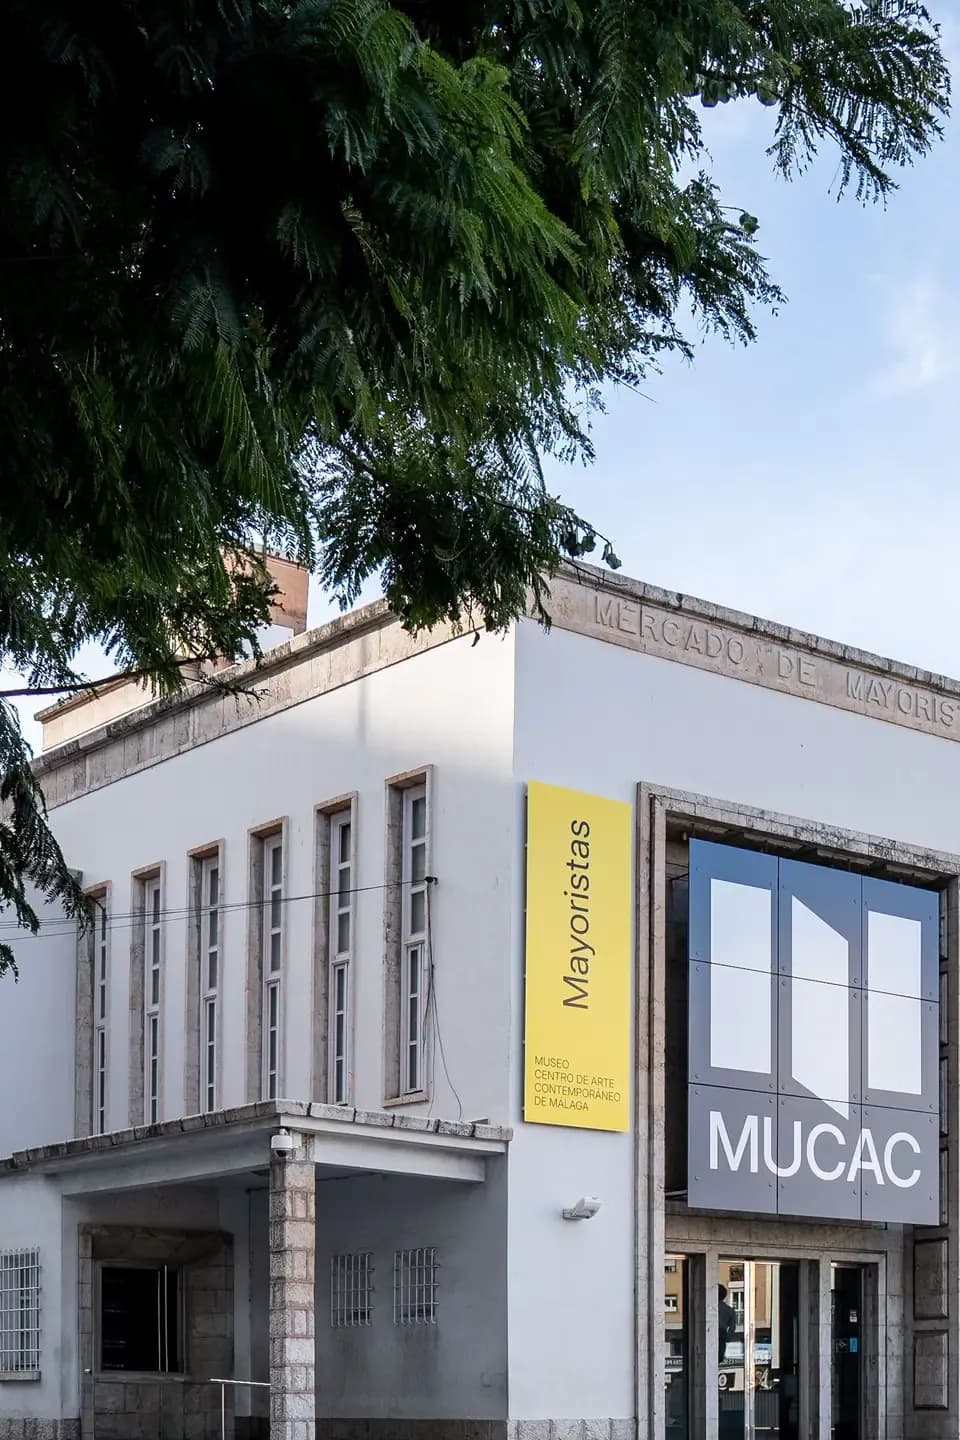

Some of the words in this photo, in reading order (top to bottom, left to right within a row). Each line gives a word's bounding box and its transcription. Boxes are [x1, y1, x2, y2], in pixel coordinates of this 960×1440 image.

[595, 596, 744, 664] MERCADO
[777, 651, 817, 687] DE
[563, 819, 595, 1010] Mayoristas
[534, 1056, 570, 1069] MUSEO
[534, 1069, 574, 1083] CENTRO
[576, 1074, 589, 1085] DE
[591, 1077, 615, 1088] ARTE
[534, 1083, 621, 1102] CONTEMPORÁNEO
[534, 1096, 547, 1106] DE
[549, 1097, 589, 1111] MÁLAGA
[709, 1111, 921, 1188] MUCAC
